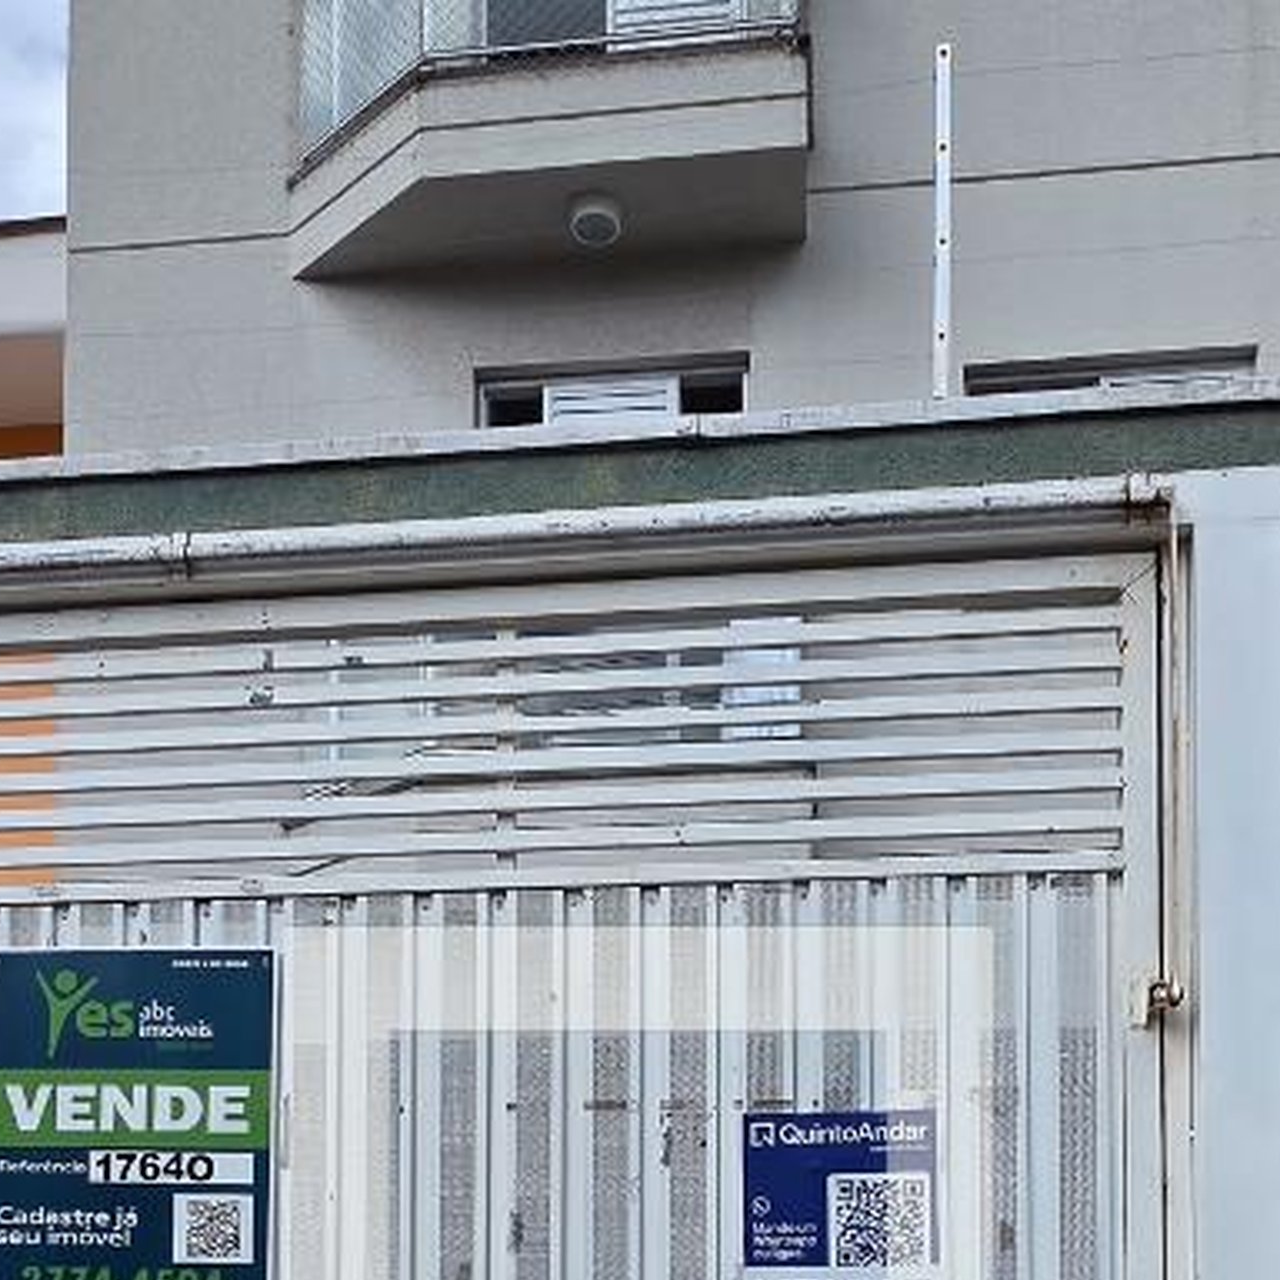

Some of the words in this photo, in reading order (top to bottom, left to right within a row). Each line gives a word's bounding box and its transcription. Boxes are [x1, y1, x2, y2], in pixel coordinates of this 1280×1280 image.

[36, 969, 137, 1059] Yes
[138, 999, 176, 1022] abc
[5, 1083, 252, 1134] VENDE
[779, 1119, 928, 1146] QuintoAndar
[96, 1153, 215, 1181] 17640
